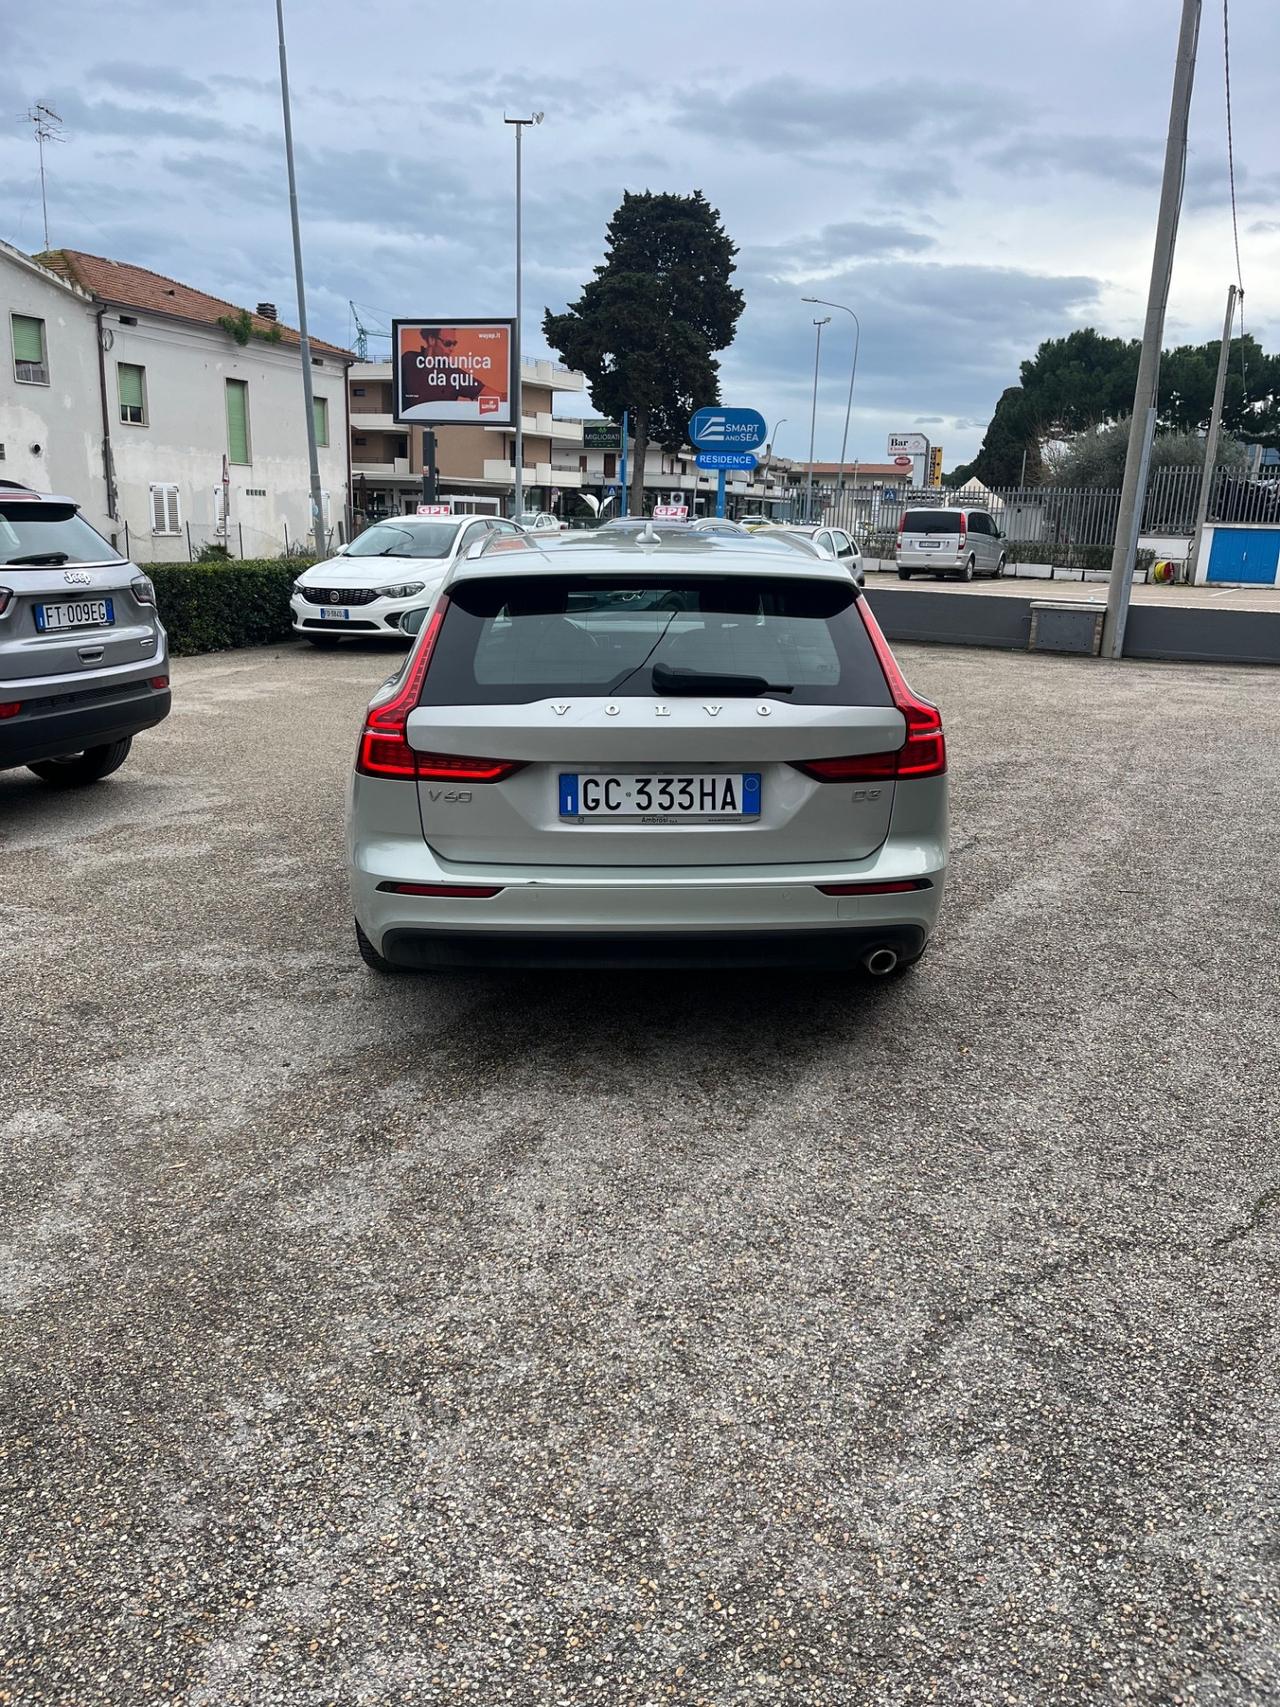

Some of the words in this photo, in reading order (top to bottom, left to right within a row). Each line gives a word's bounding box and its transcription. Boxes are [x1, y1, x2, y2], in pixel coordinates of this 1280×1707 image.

[416, 352, 492, 369] comunica
[428, 370, 447, 386] da
[450, 370, 479, 390] qui.
[725, 423, 760, 433] SMART
[585, 433, 620, 441] MIGLIORATI
[891, 438, 909, 447] Bar
[700, 455, 752, 464] RESIDENCE
[419, 506, 450, 515] GPL
[655, 506, 687, 516] GPL
[64, 571, 91, 585] Jeep
[45, 606, 62, 627] FT
[67, 602, 106, 623] 009EG
[550, 704, 773, 717] VOLVO
[427, 789, 473, 803] V60
[852, 789, 882, 802] D3
[641, 816, 669, 824] Ambrosi
